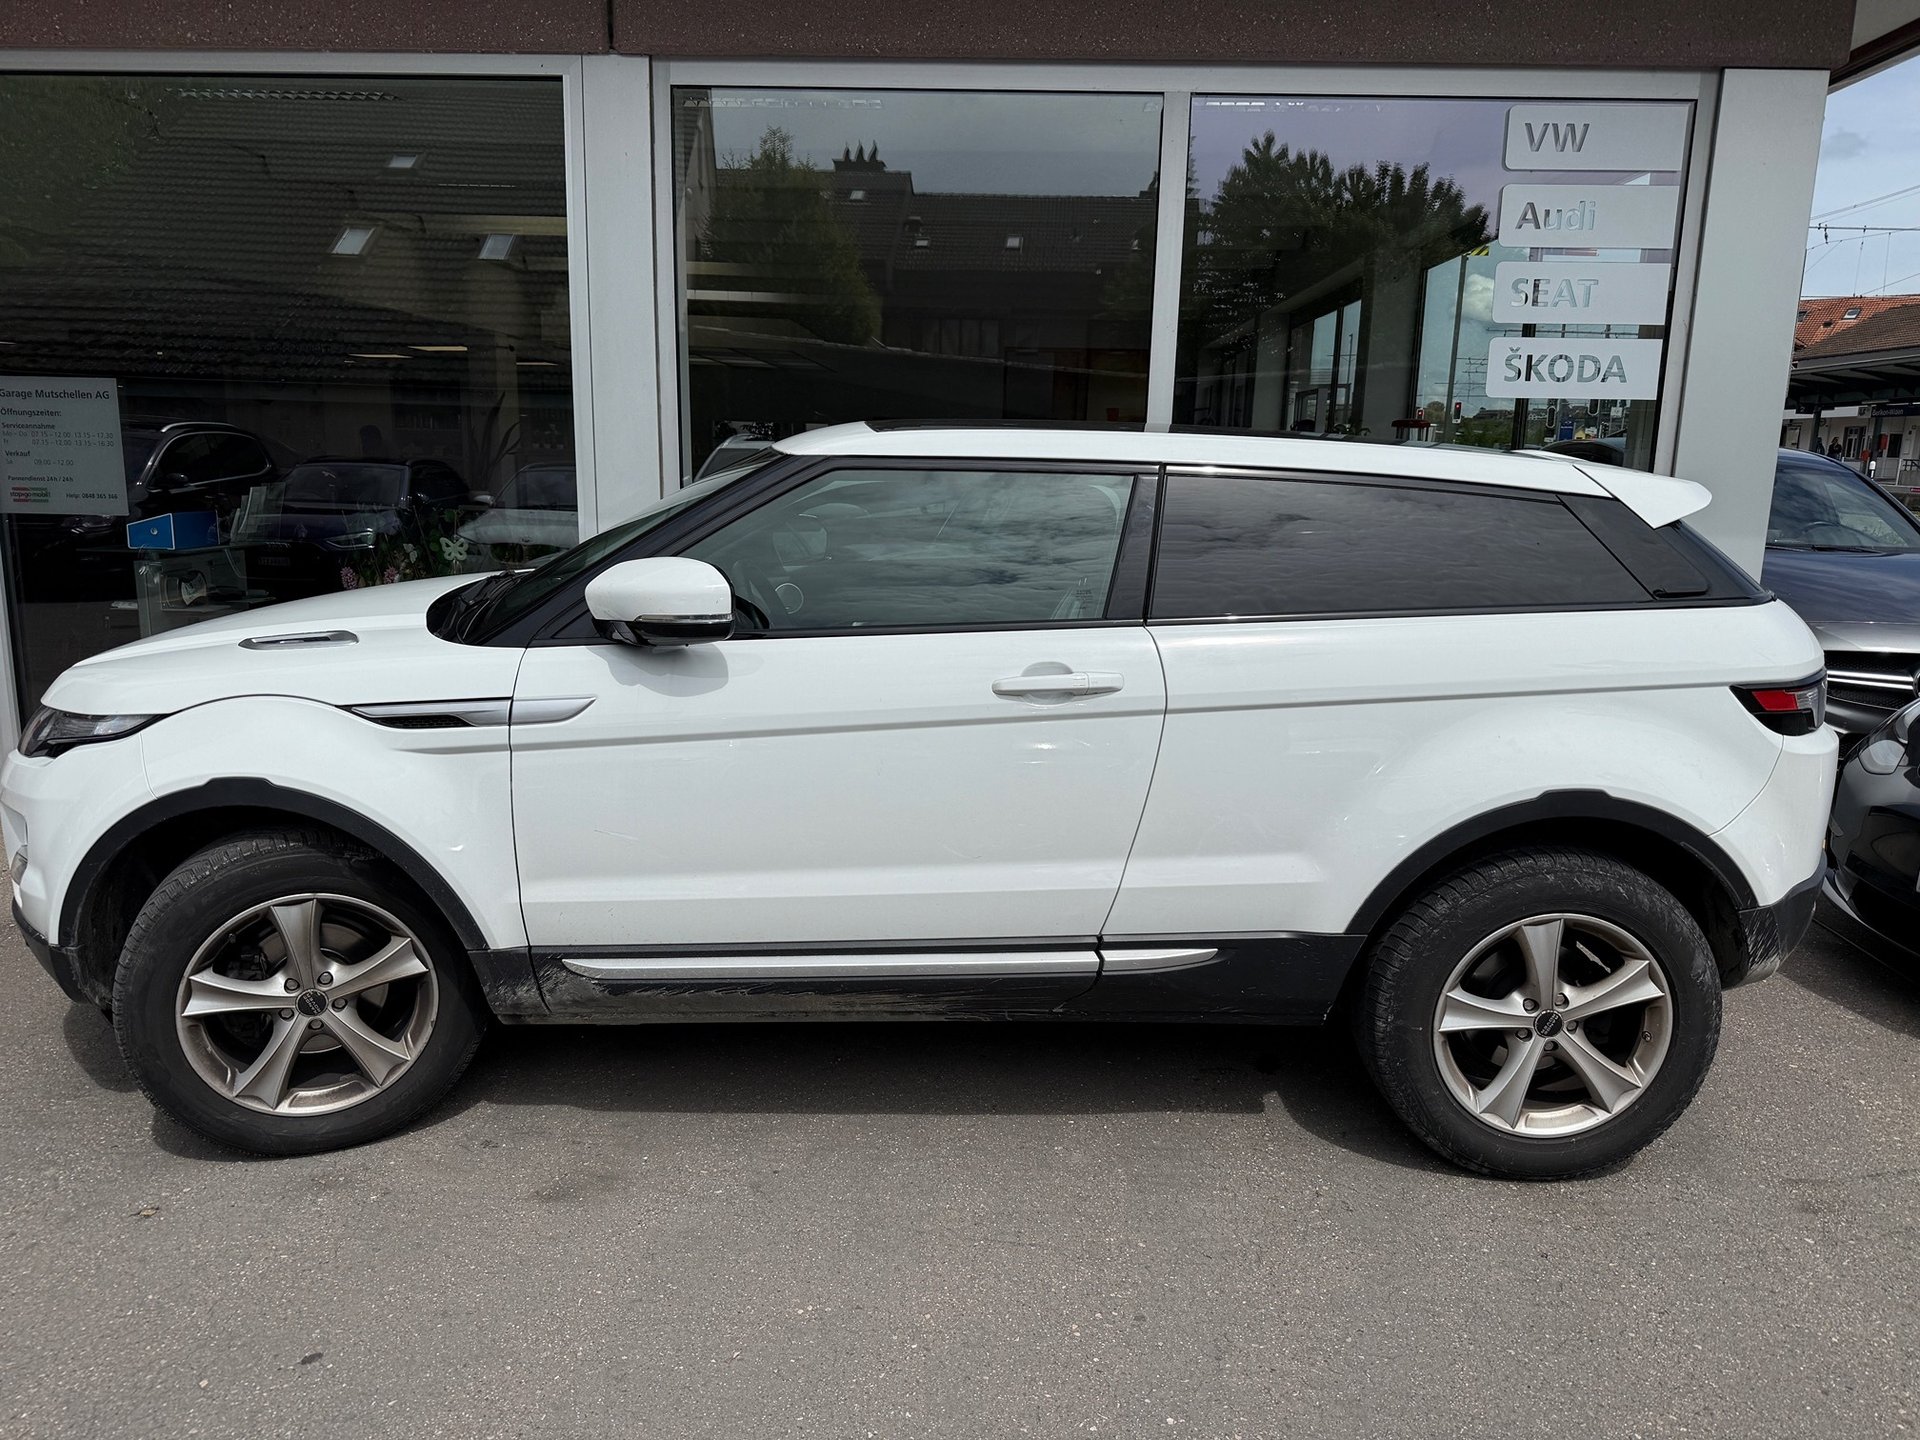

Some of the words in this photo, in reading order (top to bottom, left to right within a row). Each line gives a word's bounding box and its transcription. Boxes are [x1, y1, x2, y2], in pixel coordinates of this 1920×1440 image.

[1524, 122, 1591, 153] VW
[1515, 200, 1597, 231] Audi
[1511, 277, 1599, 309] SEAT
[1503, 346, 1628, 384] ŠKODA
[0, 388, 32, 400] Garage
[35, 389, 93, 400] Mutschellen
[95, 390, 110, 400] AG
[0, 407, 62, 417] Öffnungszeiten:
